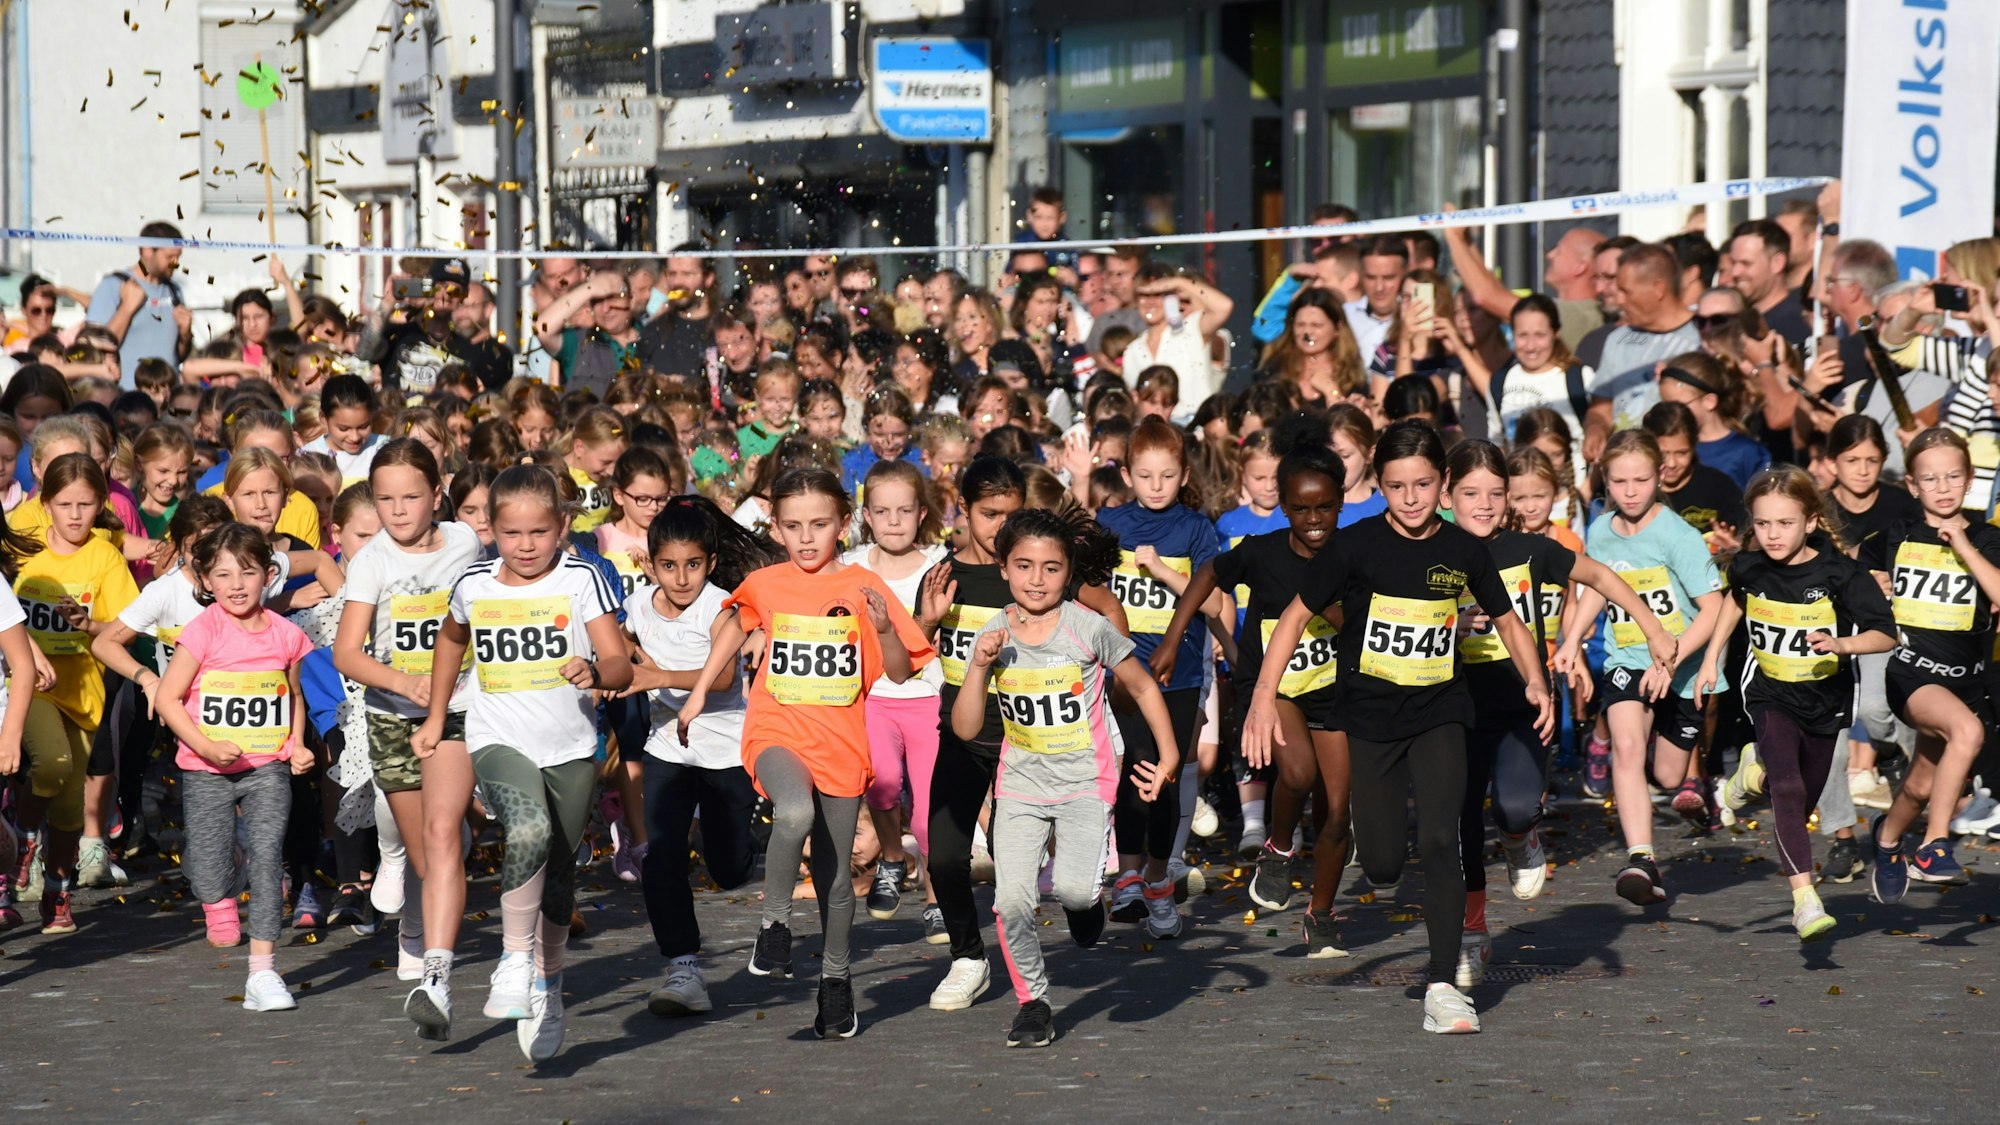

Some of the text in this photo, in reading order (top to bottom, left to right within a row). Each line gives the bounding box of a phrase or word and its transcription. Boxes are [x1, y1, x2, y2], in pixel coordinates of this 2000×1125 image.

[906, 80, 984, 97] Hermes
[1898, 0, 1947, 218] Volks
[1602, 189, 1679, 207] Volksbank
[1449, 205, 1526, 220] Volksbank
[40, 231, 124, 243] Volksbank
[1894, 566, 1973, 605] 5742
[399, 605, 427, 613] VOSS
[478, 609, 551, 619] VOSS BEW
[1378, 606, 1406, 616] VOSS
[777, 624, 801, 634] VOSS
[475, 626, 568, 663] 5685
[1368, 620, 1452, 658] 5543
[771, 640, 857, 678] 5583
[1914, 656, 1967, 678] PRO
[208, 681, 236, 689] VOSS
[1045, 678, 1064, 686] BEW
[203, 695, 282, 728] 5691
[998, 690, 1081, 726] 5915
